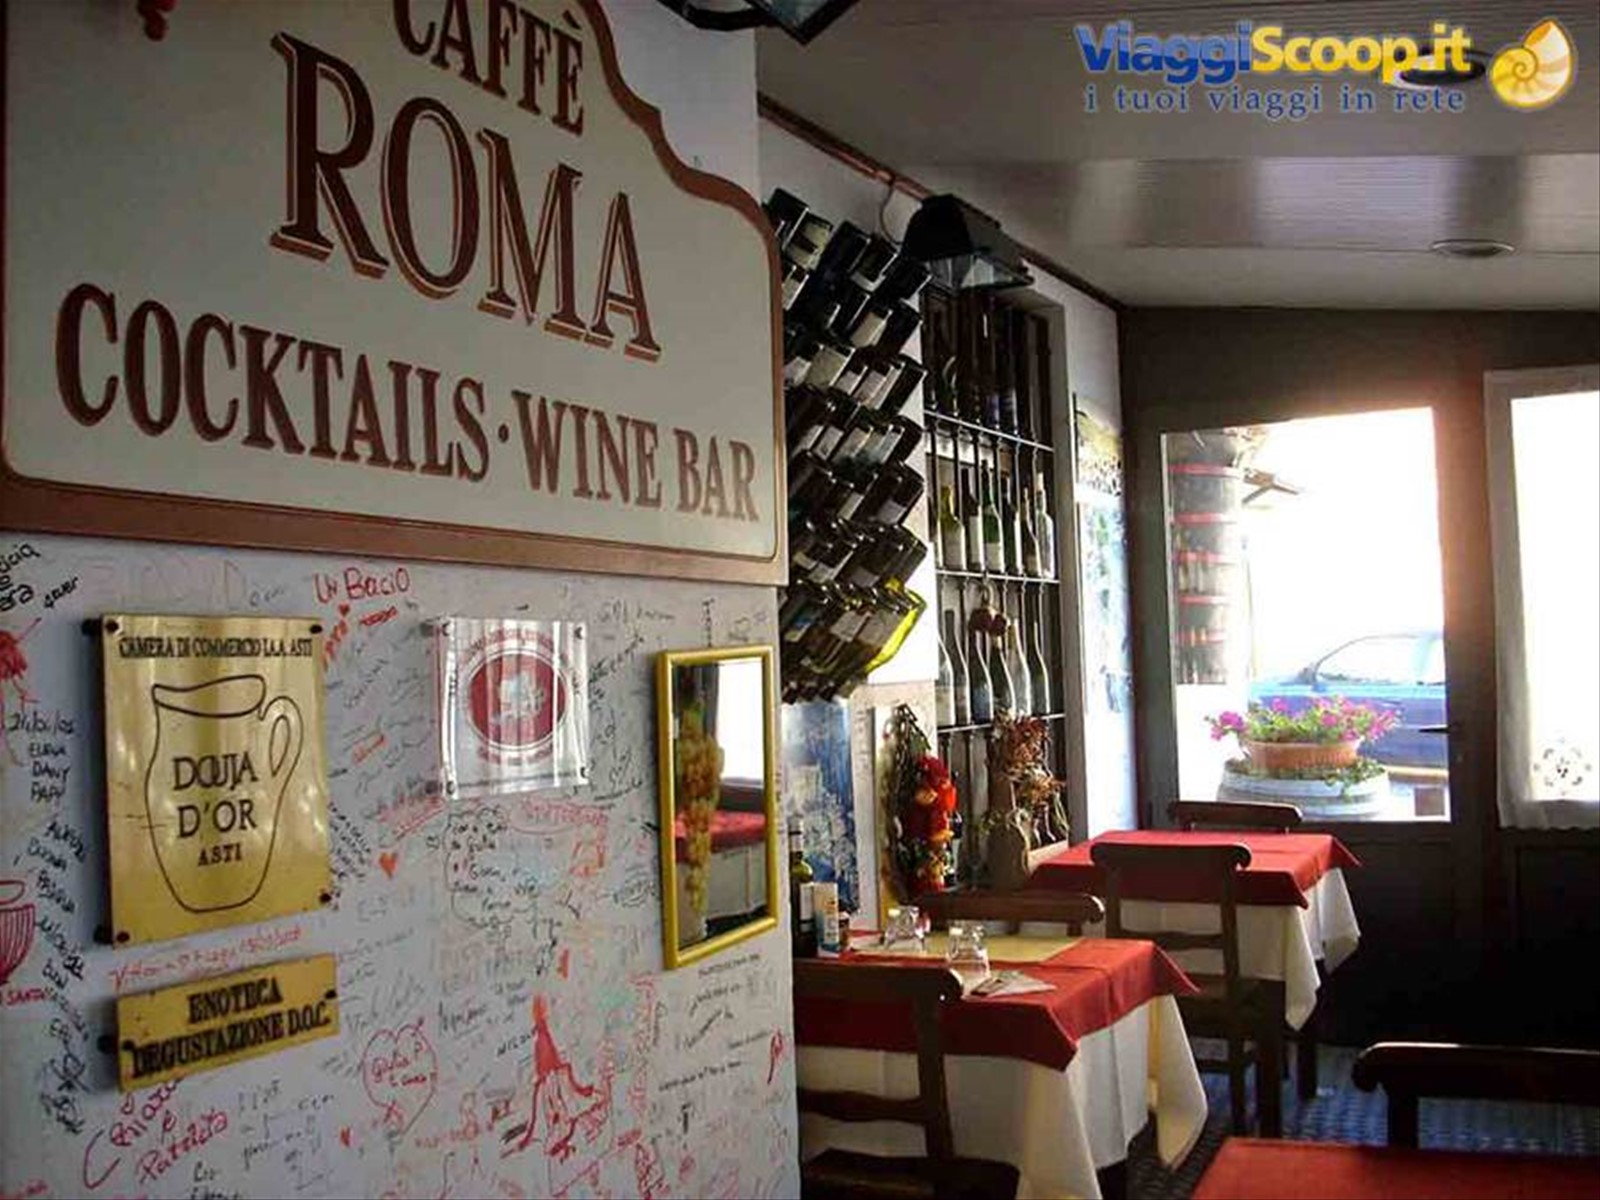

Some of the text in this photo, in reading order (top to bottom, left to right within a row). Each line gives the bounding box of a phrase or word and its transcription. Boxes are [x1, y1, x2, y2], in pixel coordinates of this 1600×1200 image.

[393, 0, 584, 137] CAFFÈ
[270, 31, 661, 363] ROMA
[55, 283, 759, 522] COCKTAILS WINE BAR
[119, 637, 175, 658] CAMERA
[177, 637, 191, 658] DI
[194, 637, 261, 657] COMMERCIO
[290, 638, 313, 657] ASTI
[173, 751, 258, 791] DOUJA
[177, 799, 257, 838] D'OR
[198, 842, 242, 867] ASTI
[188, 977, 284, 1024] ENOTECA
[131, 1012, 286, 1079] DEGUSTAZIONE
